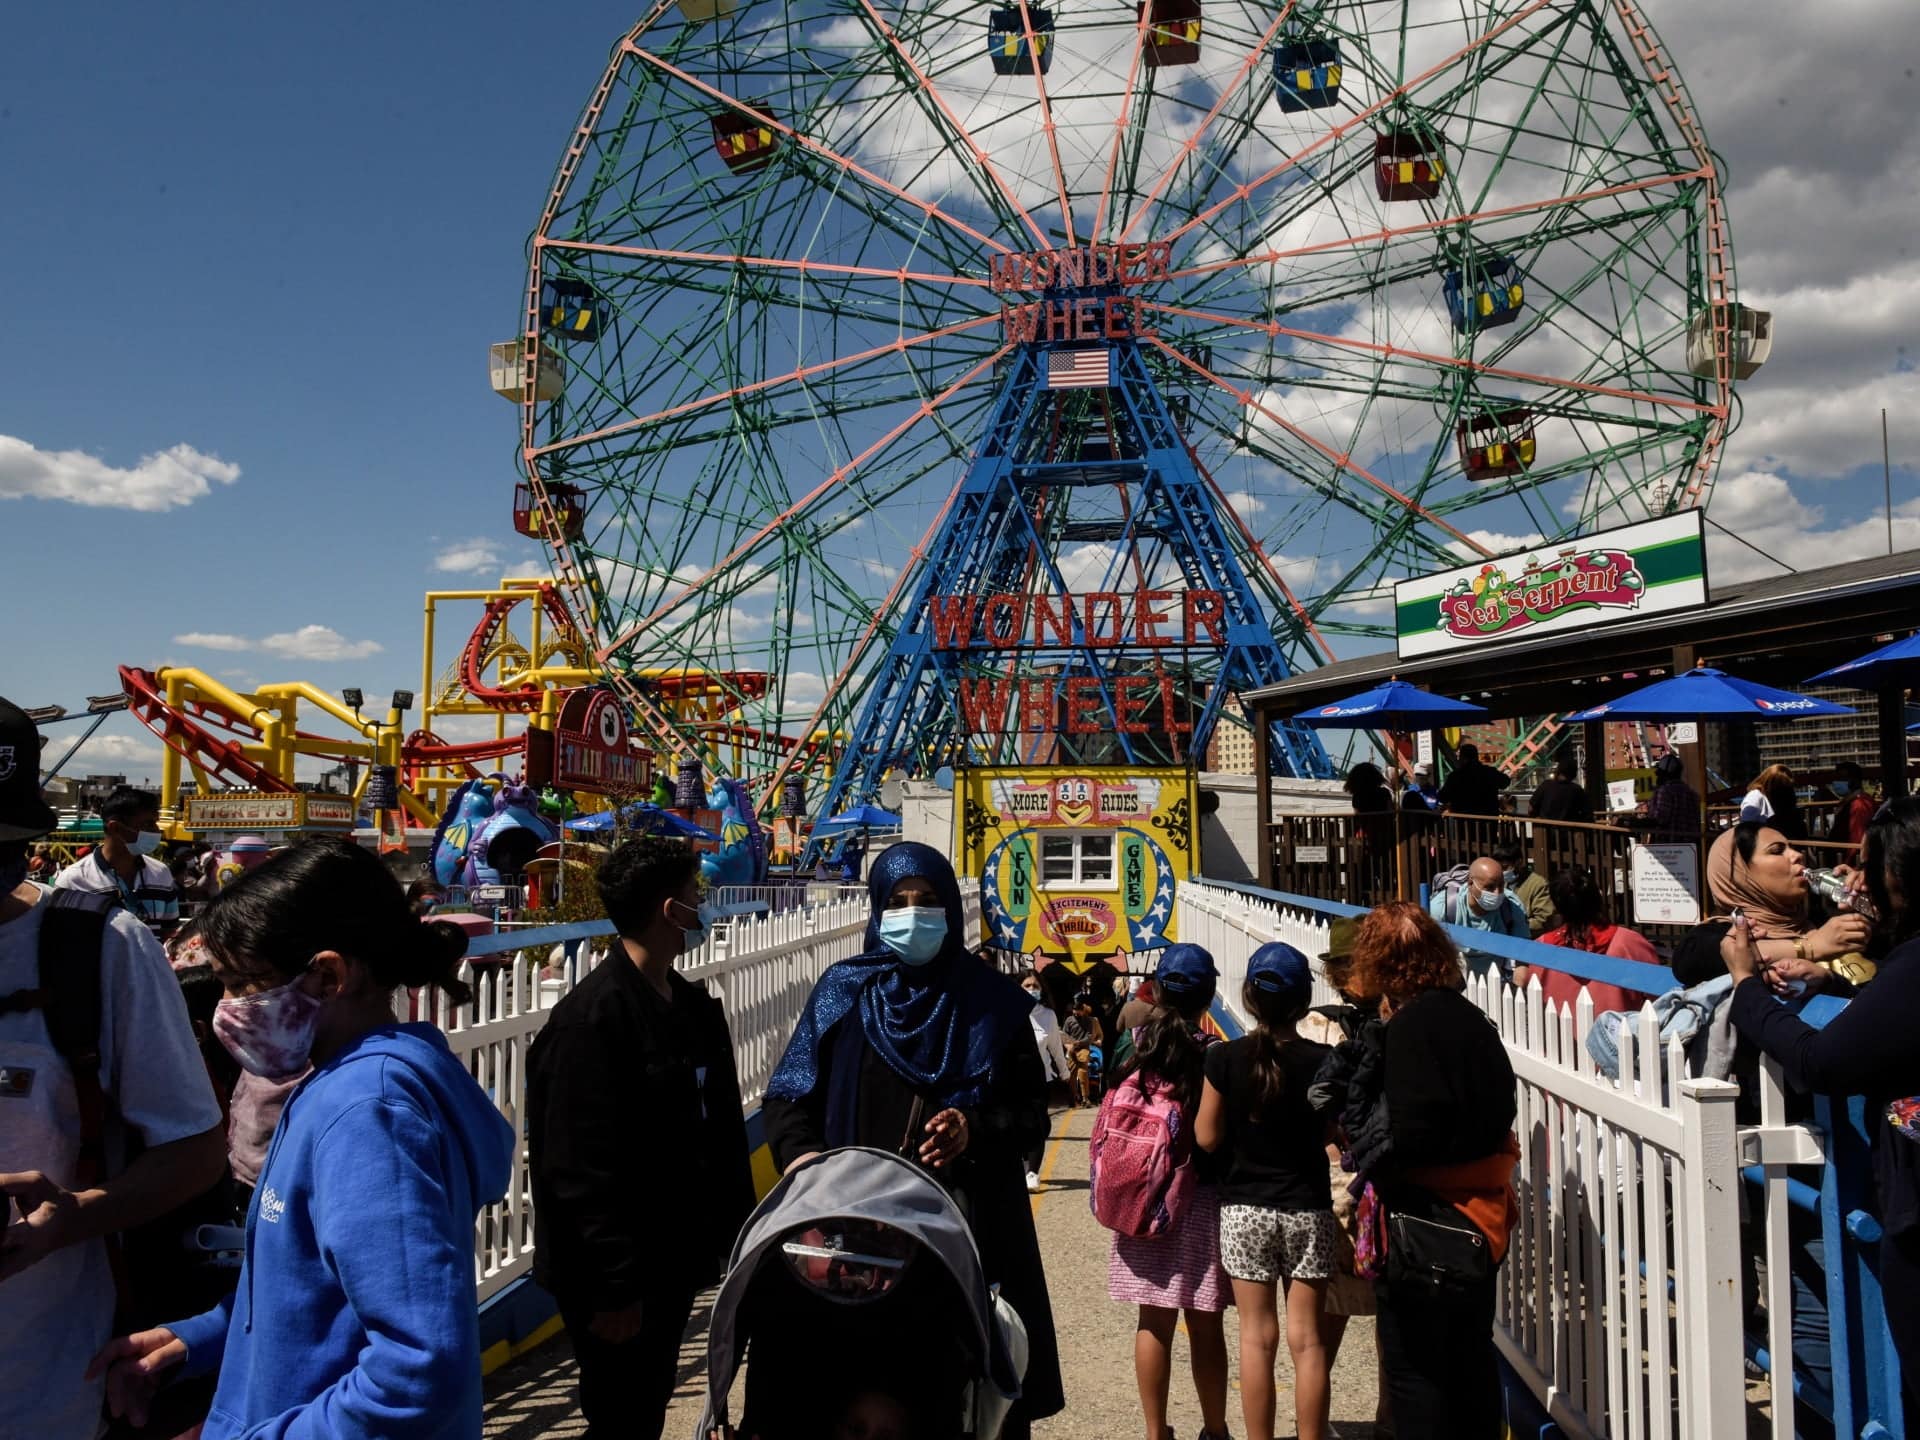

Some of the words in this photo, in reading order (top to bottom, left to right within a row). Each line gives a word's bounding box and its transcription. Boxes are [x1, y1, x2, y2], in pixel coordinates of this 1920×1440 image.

[989, 241, 1172, 292] WONDER
[1003, 295, 1159, 344] WHEEL
[1453, 599, 1501, 628] Sea
[1506, 563, 1620, 616] Serpent
[930, 589, 1226, 650] WONDER
[960, 676, 1193, 734] WHEEL
[1774, 699, 1818, 713] pepsi
[566, 744, 602, 778] TRAIN
[605, 751, 649, 785] STATION
[196, 803, 288, 819] TICKETS
[1012, 793, 1049, 813] MORE
[1101, 793, 1139, 813] RIDES
[1014, 852, 1026, 905] FUN
[1127, 845, 1141, 908] GAMES
[1050, 900, 1106, 911] EXCITEMENT
[1056, 921, 1097, 935] THRILLS
[984, 946, 1035, 974] HIS
[1126, 948, 1166, 974] WA
